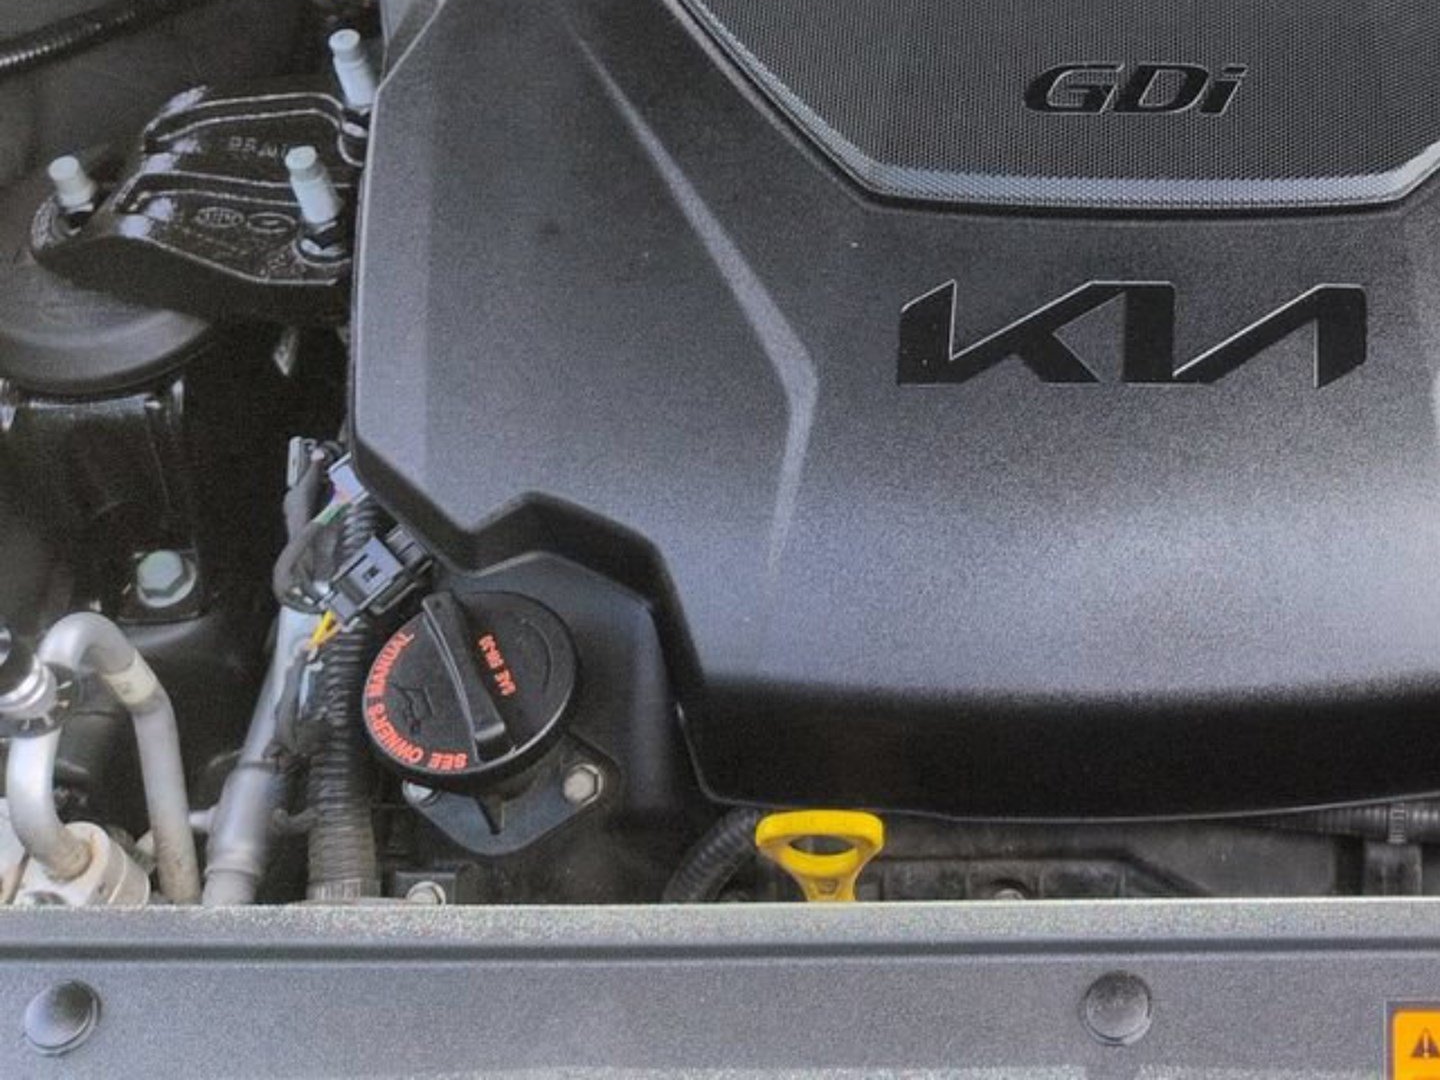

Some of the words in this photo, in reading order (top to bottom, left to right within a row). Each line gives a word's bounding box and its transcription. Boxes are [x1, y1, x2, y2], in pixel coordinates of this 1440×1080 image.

[1023, 62, 1248, 116] GDi
[897, 279, 1367, 388] KIA
[366, 632, 415, 698] MANUAL
[426, 752, 468, 770] SEE
